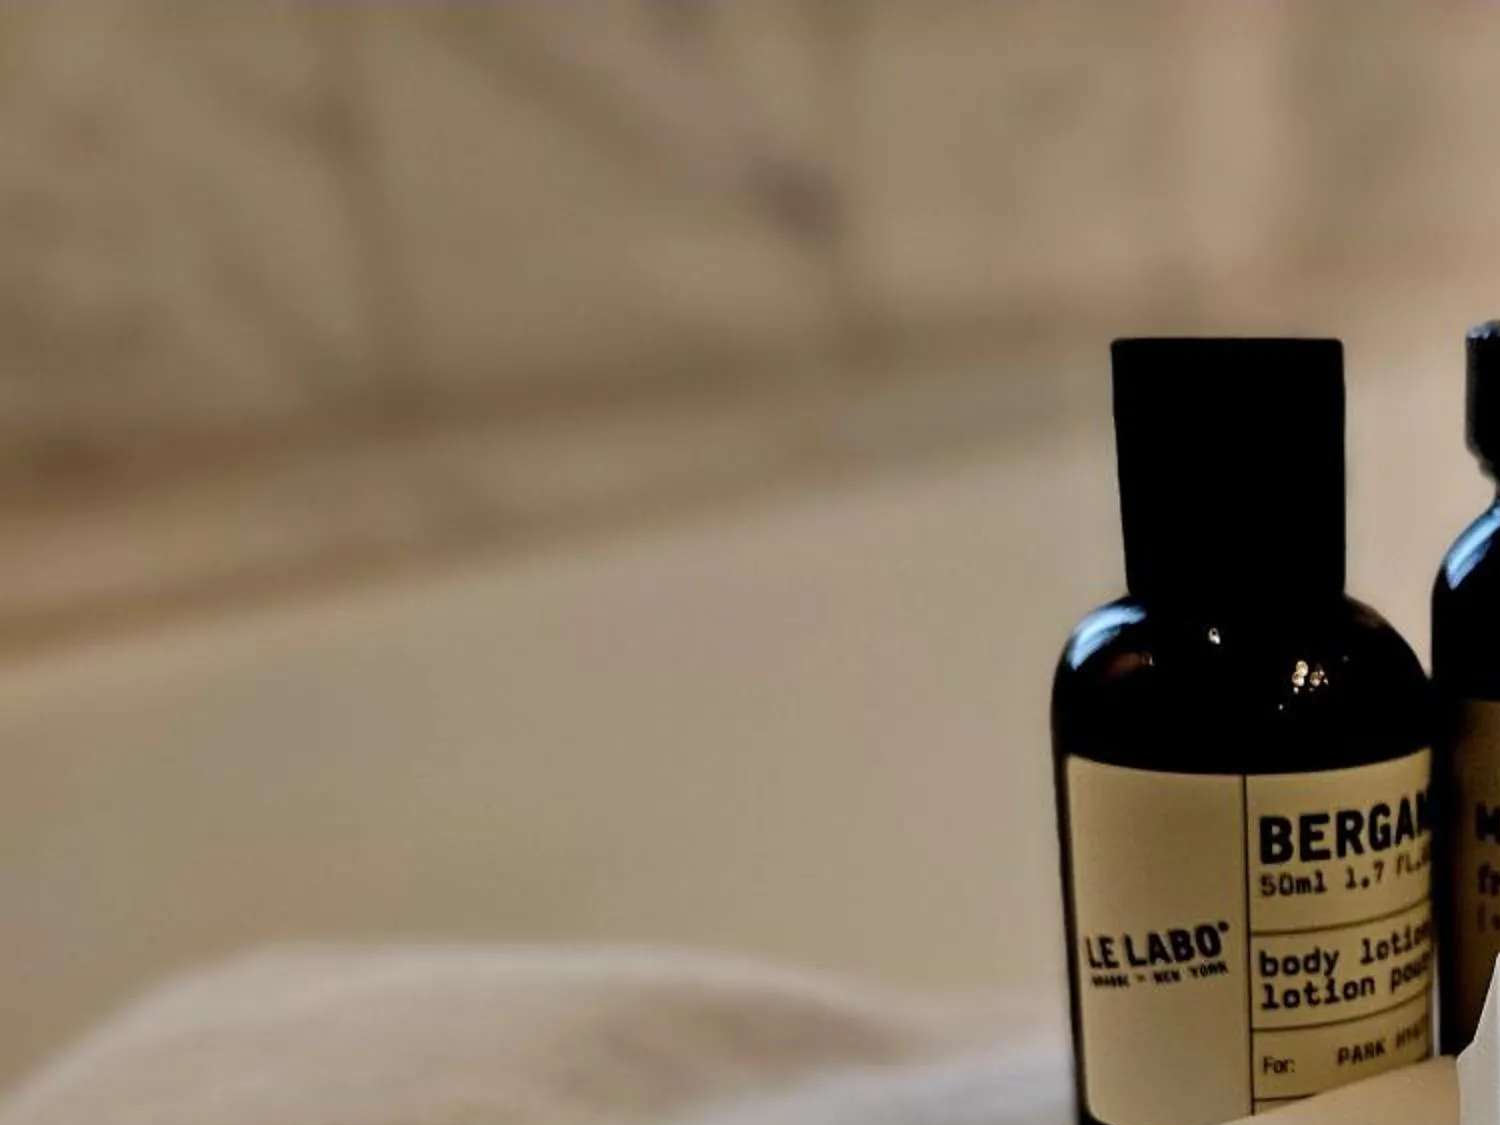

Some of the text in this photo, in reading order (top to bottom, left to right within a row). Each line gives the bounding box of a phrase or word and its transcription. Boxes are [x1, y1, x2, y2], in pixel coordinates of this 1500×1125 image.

[1260, 868, 1326, 897] 50ml
[1345, 860, 1385, 890] 1.7
[1085, 935, 1119, 969] LE
[1259, 946, 1340, 979] body
[1261, 976, 1376, 1010] lotion
[1263, 1056, 1296, 1075] For:
